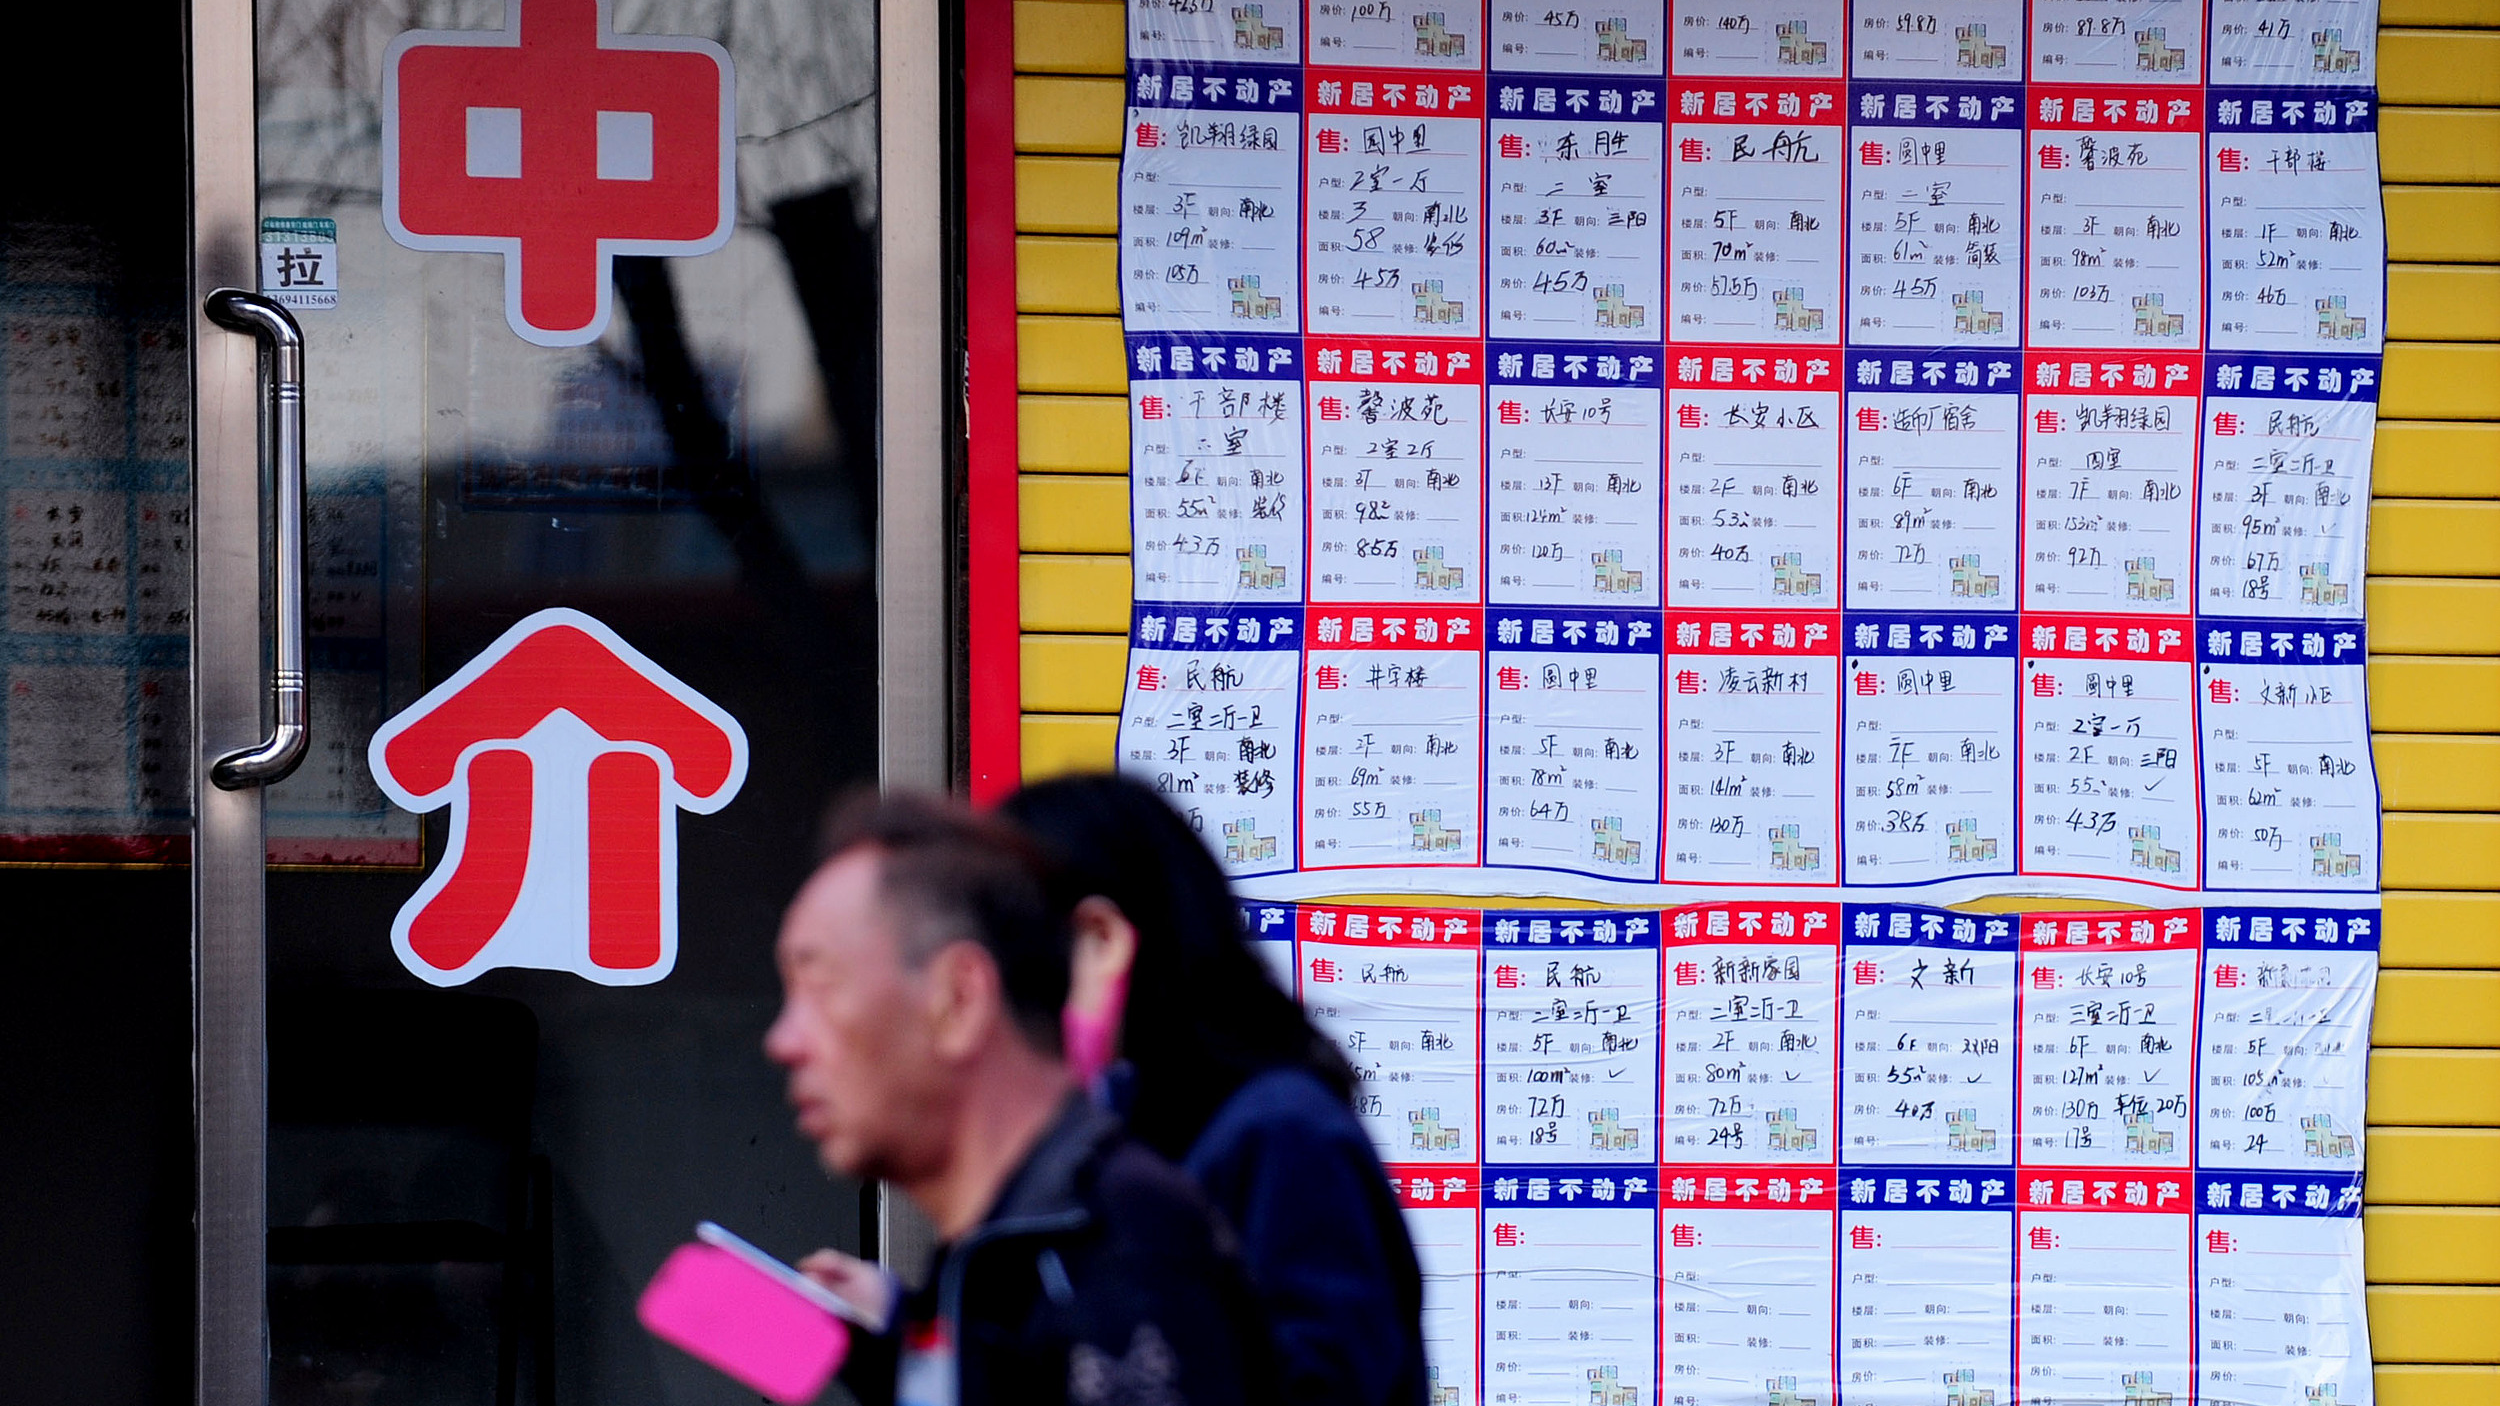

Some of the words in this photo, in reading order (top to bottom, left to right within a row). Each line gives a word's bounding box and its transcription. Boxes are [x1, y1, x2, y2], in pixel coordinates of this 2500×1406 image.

[1352, 1, 1391, 22] 100万
[1544, 11, 1579, 28] 45万
[1718, 15, 1749, 34] 140万
[2258, 18, 2291, 39] 41万
[1138, 74, 1291, 103] 新居不动产
[1318, 81, 1470, 109] 新居不动产
[1500, 86, 1654, 114] 新居不动产
[1681, 91, 1832, 117] 新居不动产
[1861, 93, 2014, 120] 新居不动产
[2040, 97, 2190, 124] 新居不动产
[2218, 100, 2367, 125] 新居不动产
[1733, 130, 1819, 162] 民航
[1423, 202, 1468, 226] 南北
[1790, 211, 1819, 232] 南北
[277, 247, 324, 287] 拉
[1354, 268, 1400, 288] 45万
[1532, 271, 1588, 292] 45万
[1892, 276, 1938, 299] 45万
[1137, 346, 1291, 372] 新居不动产
[1318, 348, 1470, 376] 新居不动产
[1498, 353, 1653, 380] 新居不动产
[1678, 357, 1829, 384] 新居不动产
[1857, 360, 2011, 386] 新居不动产
[2037, 362, 2189, 388] 新居不动产
[2217, 364, 2374, 393] 新居不动产
[1189, 388, 1287, 424] 干部楼
[1542, 398, 1613, 424] 长安10号
[1724, 402, 1819, 429] 长安小区
[2268, 410, 2320, 437] 民航
[1427, 469, 1460, 490] 南北
[1172, 533, 1220, 556] 43万
[1357, 537, 1398, 559] 85万
[1711, 544, 1749, 562] 40万
[2068, 547, 2101, 568] 92万
[2247, 552, 2279, 572] 67万
[2243, 576, 2269, 599] 18号
[1141, 615, 1293, 643] 新居不动产
[1318, 617, 1470, 643] 新居不动产
[1498, 618, 1651, 646] 新居不动产
[1677, 622, 1827, 648] 新居不动产
[1855, 623, 2007, 649] 新居不动产
[2032, 625, 2181, 654] 新居不动产
[2208, 630, 2356, 657] 新居不动产
[1186, 659, 1243, 691] 民航
[1366, 663, 1428, 690] 井字楼
[1718, 666, 1808, 694] 凌云新村
[2320, 754, 2355, 776] 南北
[1353, 802, 1386, 818] 55万
[1530, 800, 1568, 822] 64万
[2066, 809, 2117, 836] 43万
[2254, 827, 2281, 851] 50万
[1310, 911, 1467, 942] 新居不动产
[1495, 918, 1649, 943] 新居不动产
[1674, 911, 1827, 938] 新居不动产
[1854, 913, 2009, 942] 新居不动产
[2032, 917, 2188, 945] 新居不动产
[2216, 916, 2370, 943] 新居不动产
[1362, 963, 1408, 983] 民航
[1546, 962, 1601, 986] 民航
[1911, 958, 1973, 990] 文新
[2076, 963, 2147, 988] 长安10号
[1529, 1096, 1564, 1119] 72万
[1709, 1097, 1741, 1116] 72万
[2062, 1101, 2098, 1119] 130万
[2157, 1095, 2186, 1118] 20万
[2244, 1103, 2276, 1122] 100万
[1530, 1122, 1557, 1144] 18号
[1707, 1127, 1743, 1149] 24号
[2065, 1128, 2091, 1148] 17号
[2244, 1134, 2268, 1154] 24
[1494, 1177, 1647, 1201] 新居不动产
[1672, 1177, 1823, 1202] 新居不动产
[1851, 1178, 2004, 1204] 新居不动产
[2029, 1179, 2179, 1207] 新居不动产
